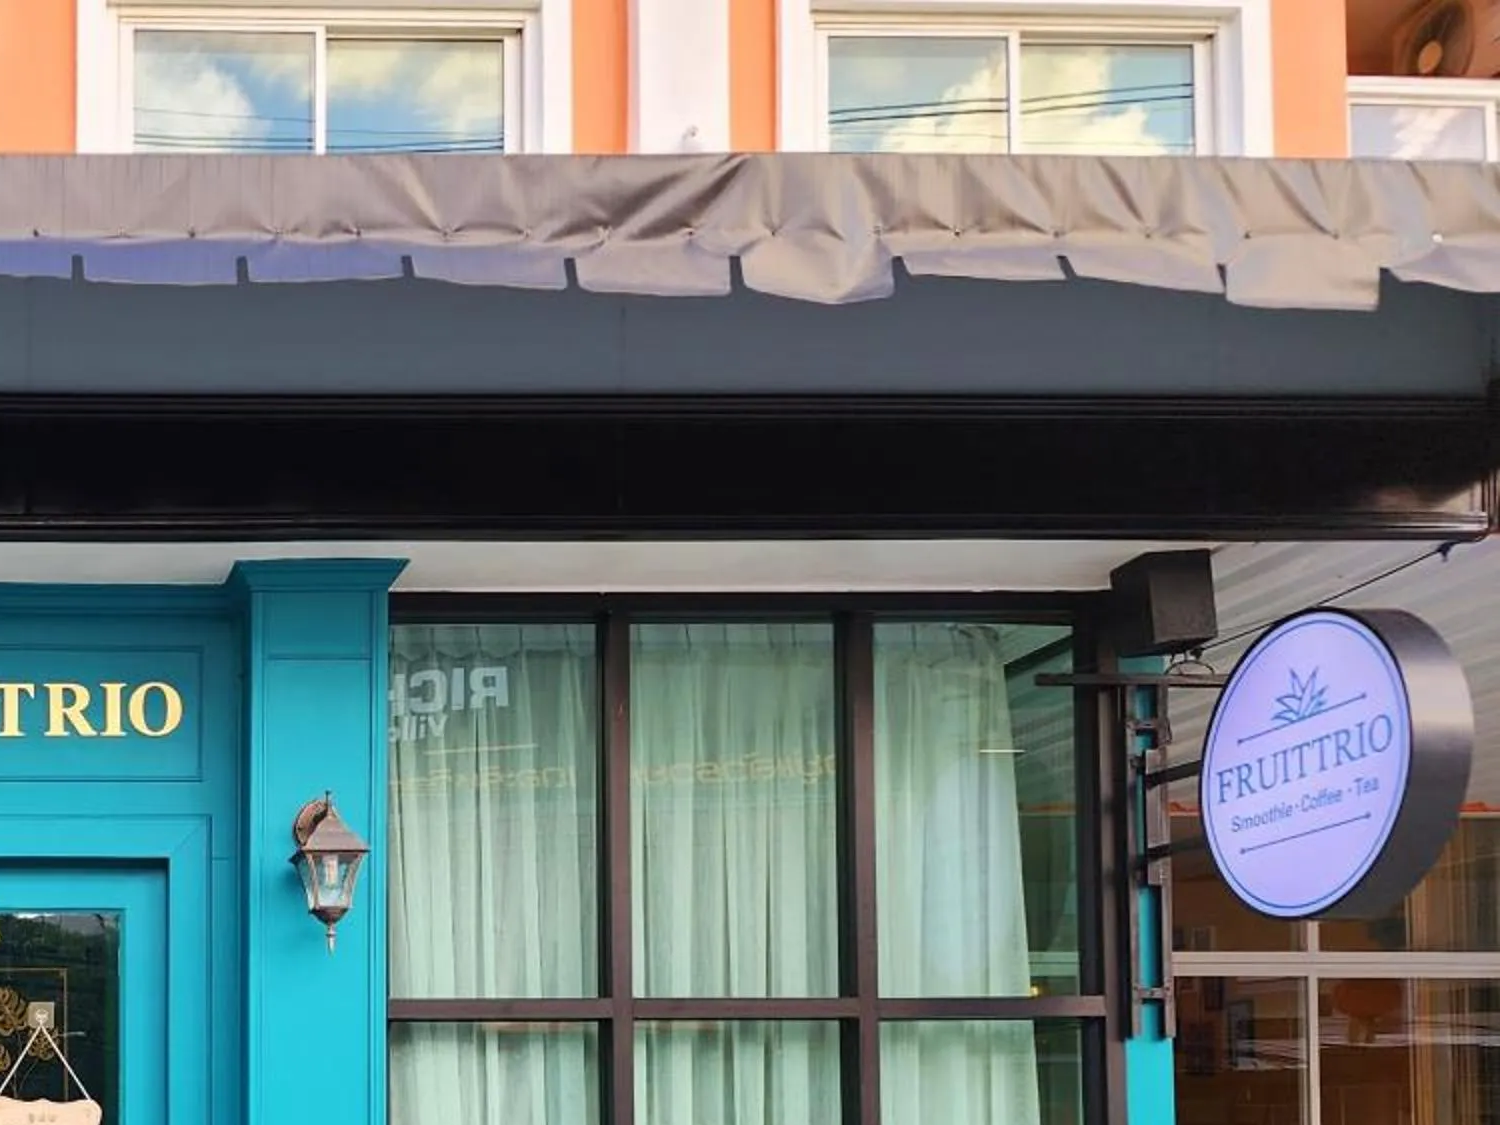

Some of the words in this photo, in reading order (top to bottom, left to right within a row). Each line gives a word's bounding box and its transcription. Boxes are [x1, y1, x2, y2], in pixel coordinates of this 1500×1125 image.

[1217, 713, 1393, 805] FRUITTRIO
[1231, 802, 1294, 833] Smoothie
[1301, 789, 1343, 813] Coffee
[1353, 777, 1380, 797] Tea
